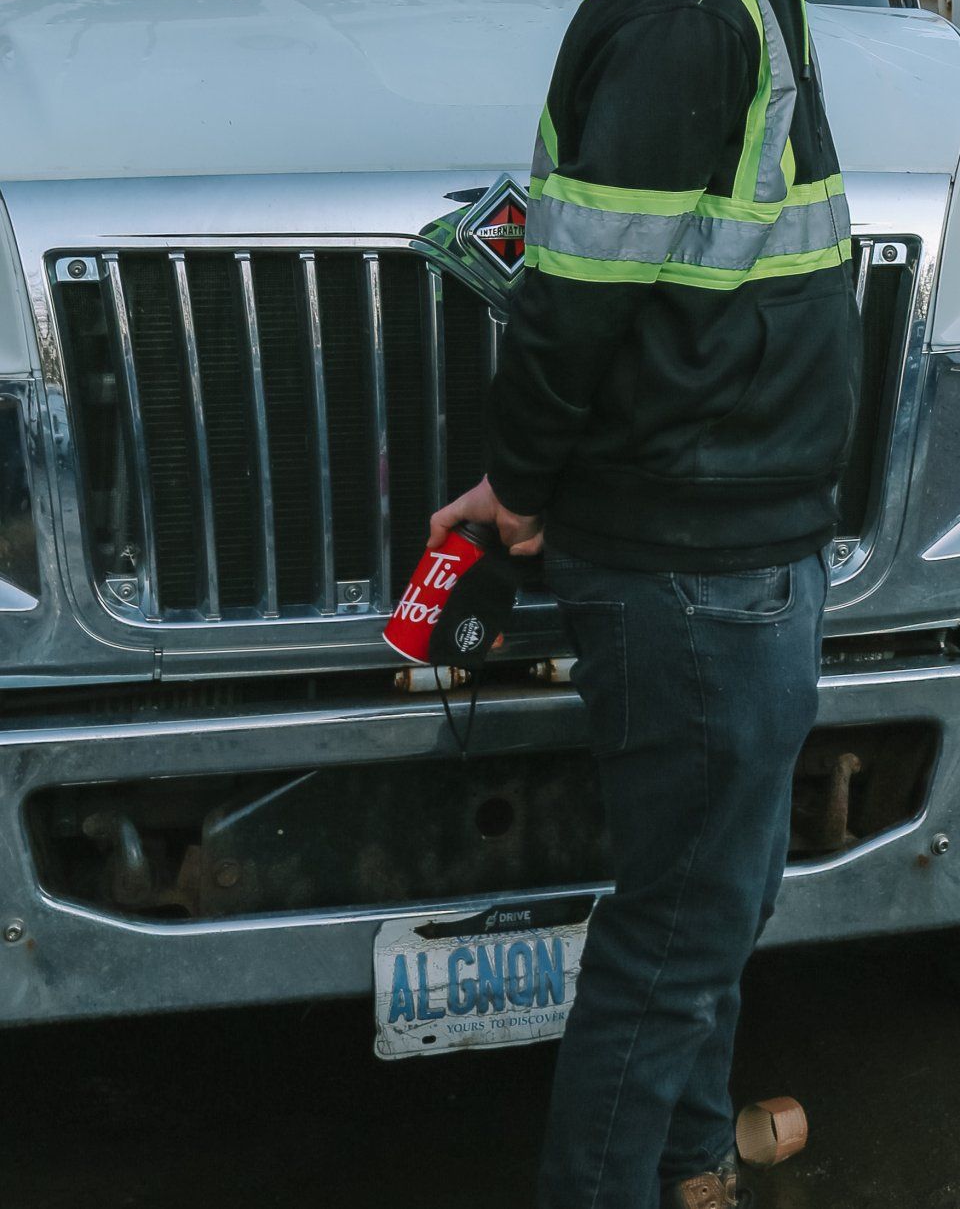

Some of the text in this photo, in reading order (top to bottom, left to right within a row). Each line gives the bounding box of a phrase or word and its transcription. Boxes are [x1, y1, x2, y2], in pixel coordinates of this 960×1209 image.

[480, 225, 525, 237] INTERNATIO
[499, 910, 531, 923] DRIVE
[447, 1011, 565, 1034] YOURS TO DISCOVER
